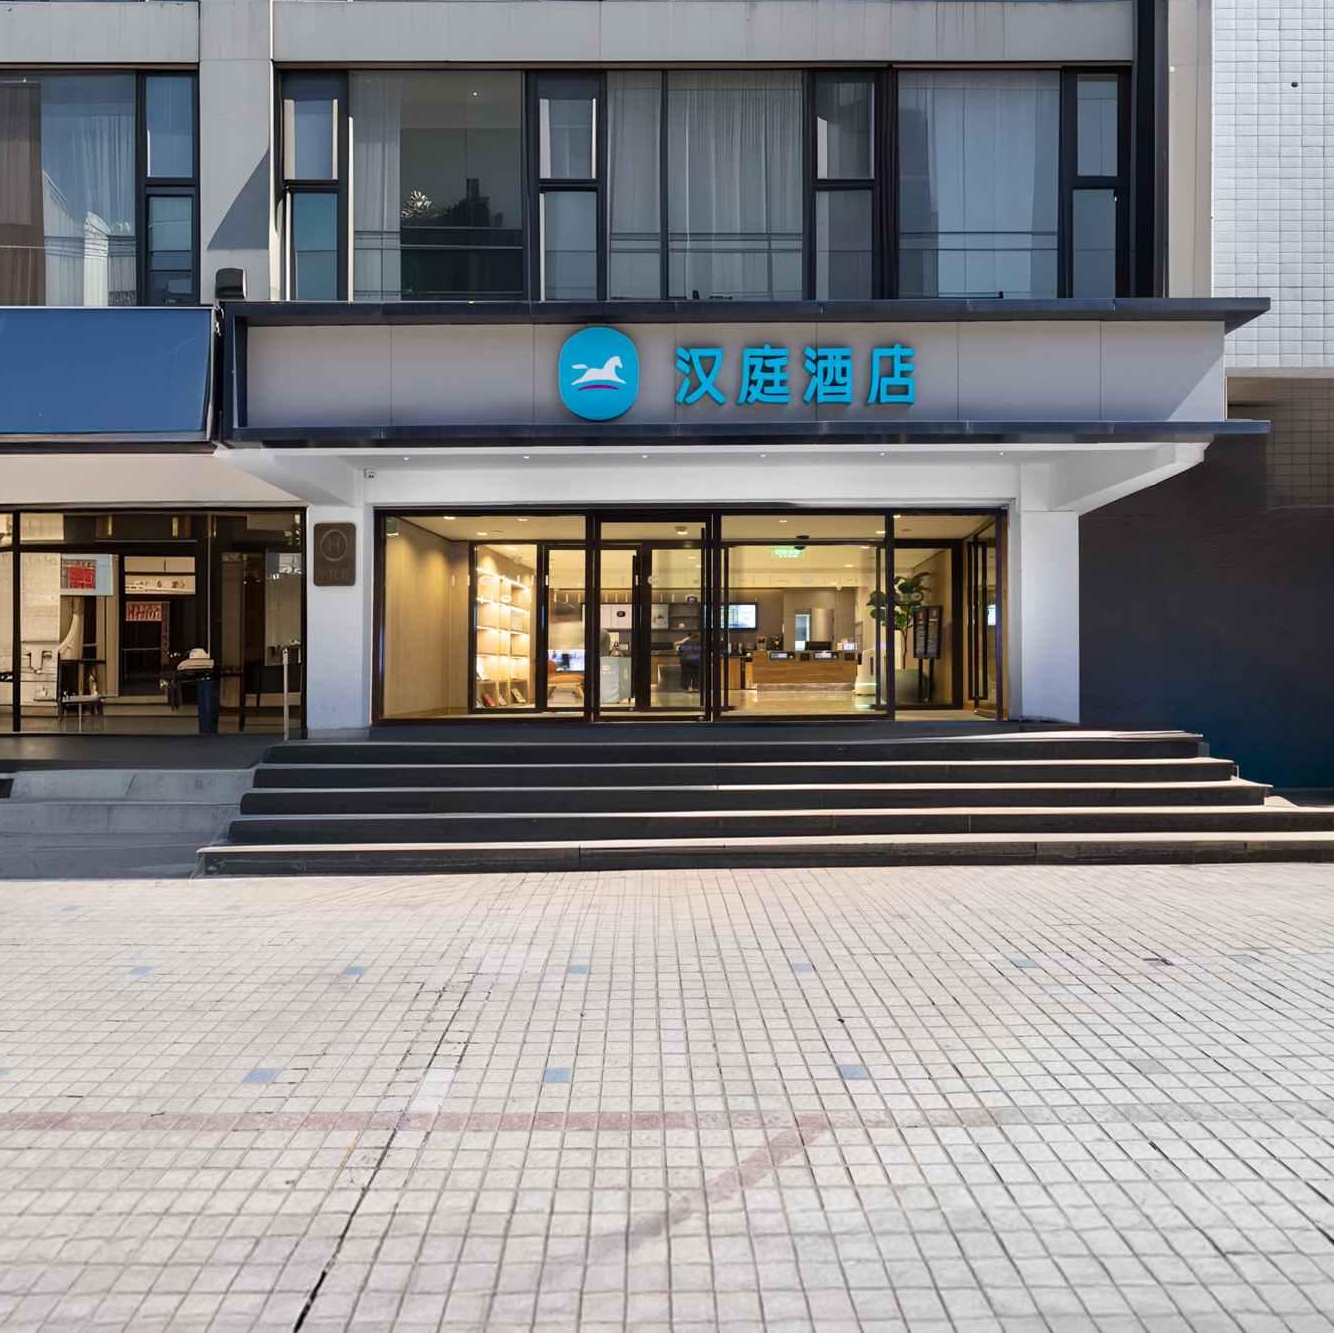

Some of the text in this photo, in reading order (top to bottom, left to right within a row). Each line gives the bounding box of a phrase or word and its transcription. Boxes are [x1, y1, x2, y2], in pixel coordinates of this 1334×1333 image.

[675, 344, 916, 405] 汉庭酒店
[319, 568, 350, 580] 华住会
